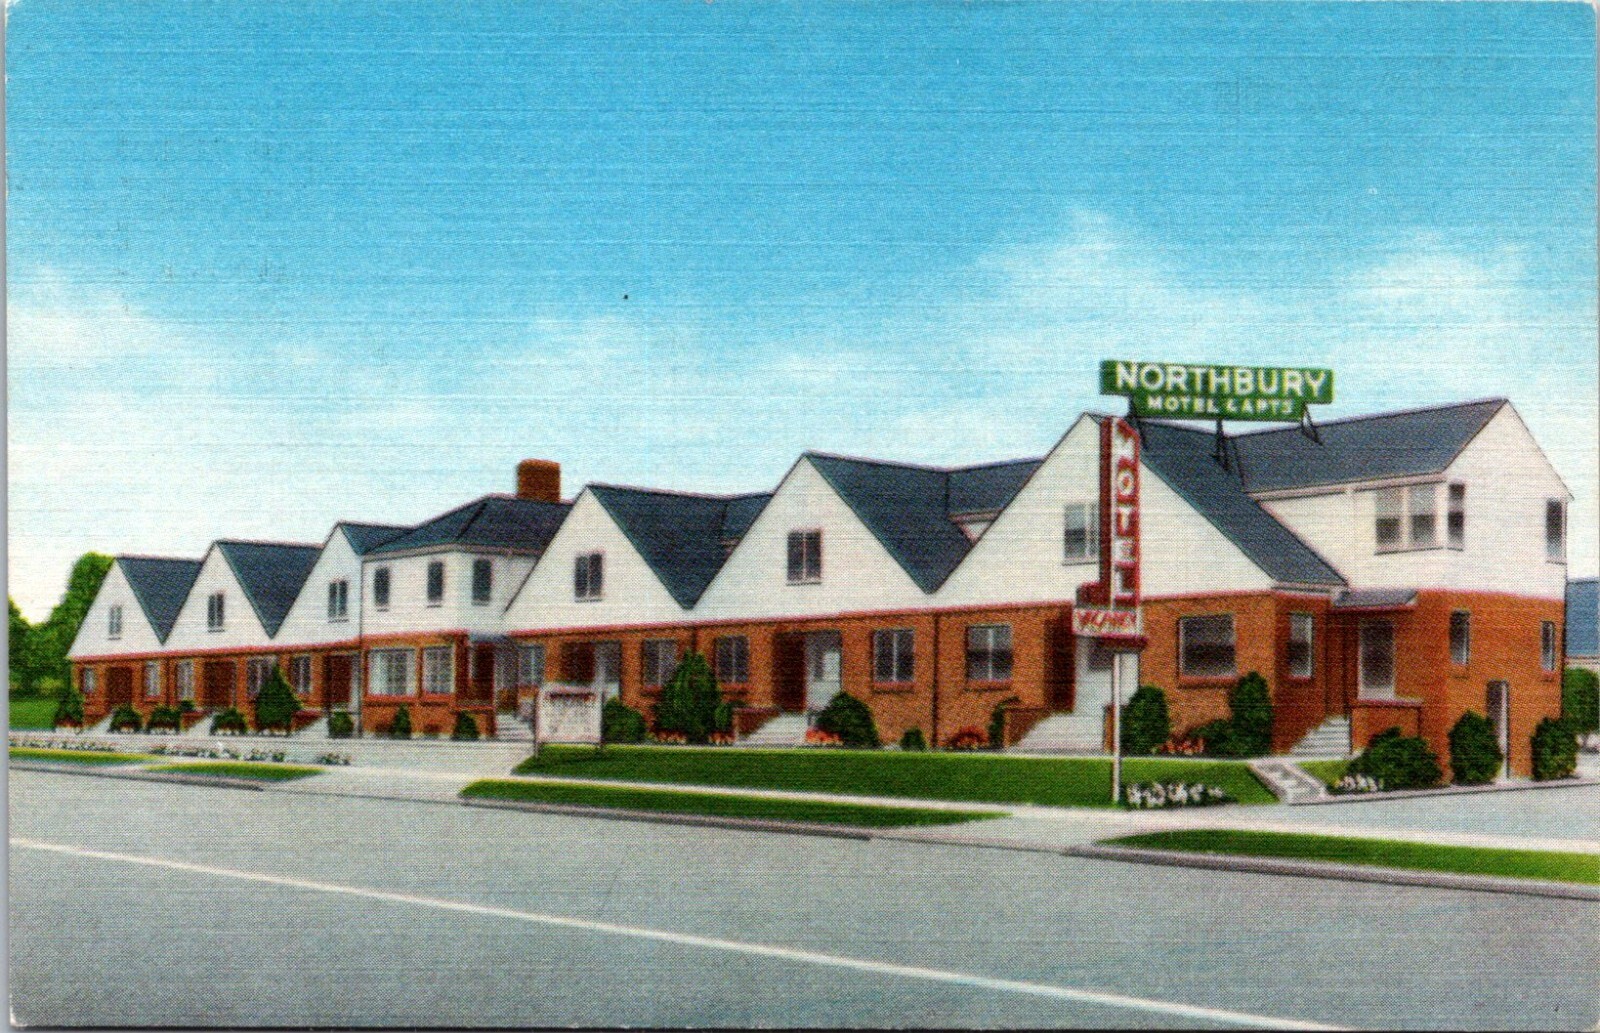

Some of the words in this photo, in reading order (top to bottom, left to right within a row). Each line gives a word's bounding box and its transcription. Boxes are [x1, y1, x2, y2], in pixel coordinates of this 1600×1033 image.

[1115, 362, 1326, 397] NORTHBURY
[1148, 397, 1219, 412] MOTEL
[1226, 399, 1239, 413] &
[1241, 400, 1294, 415] APTS
[1114, 431, 1136, 596] MOTEL
